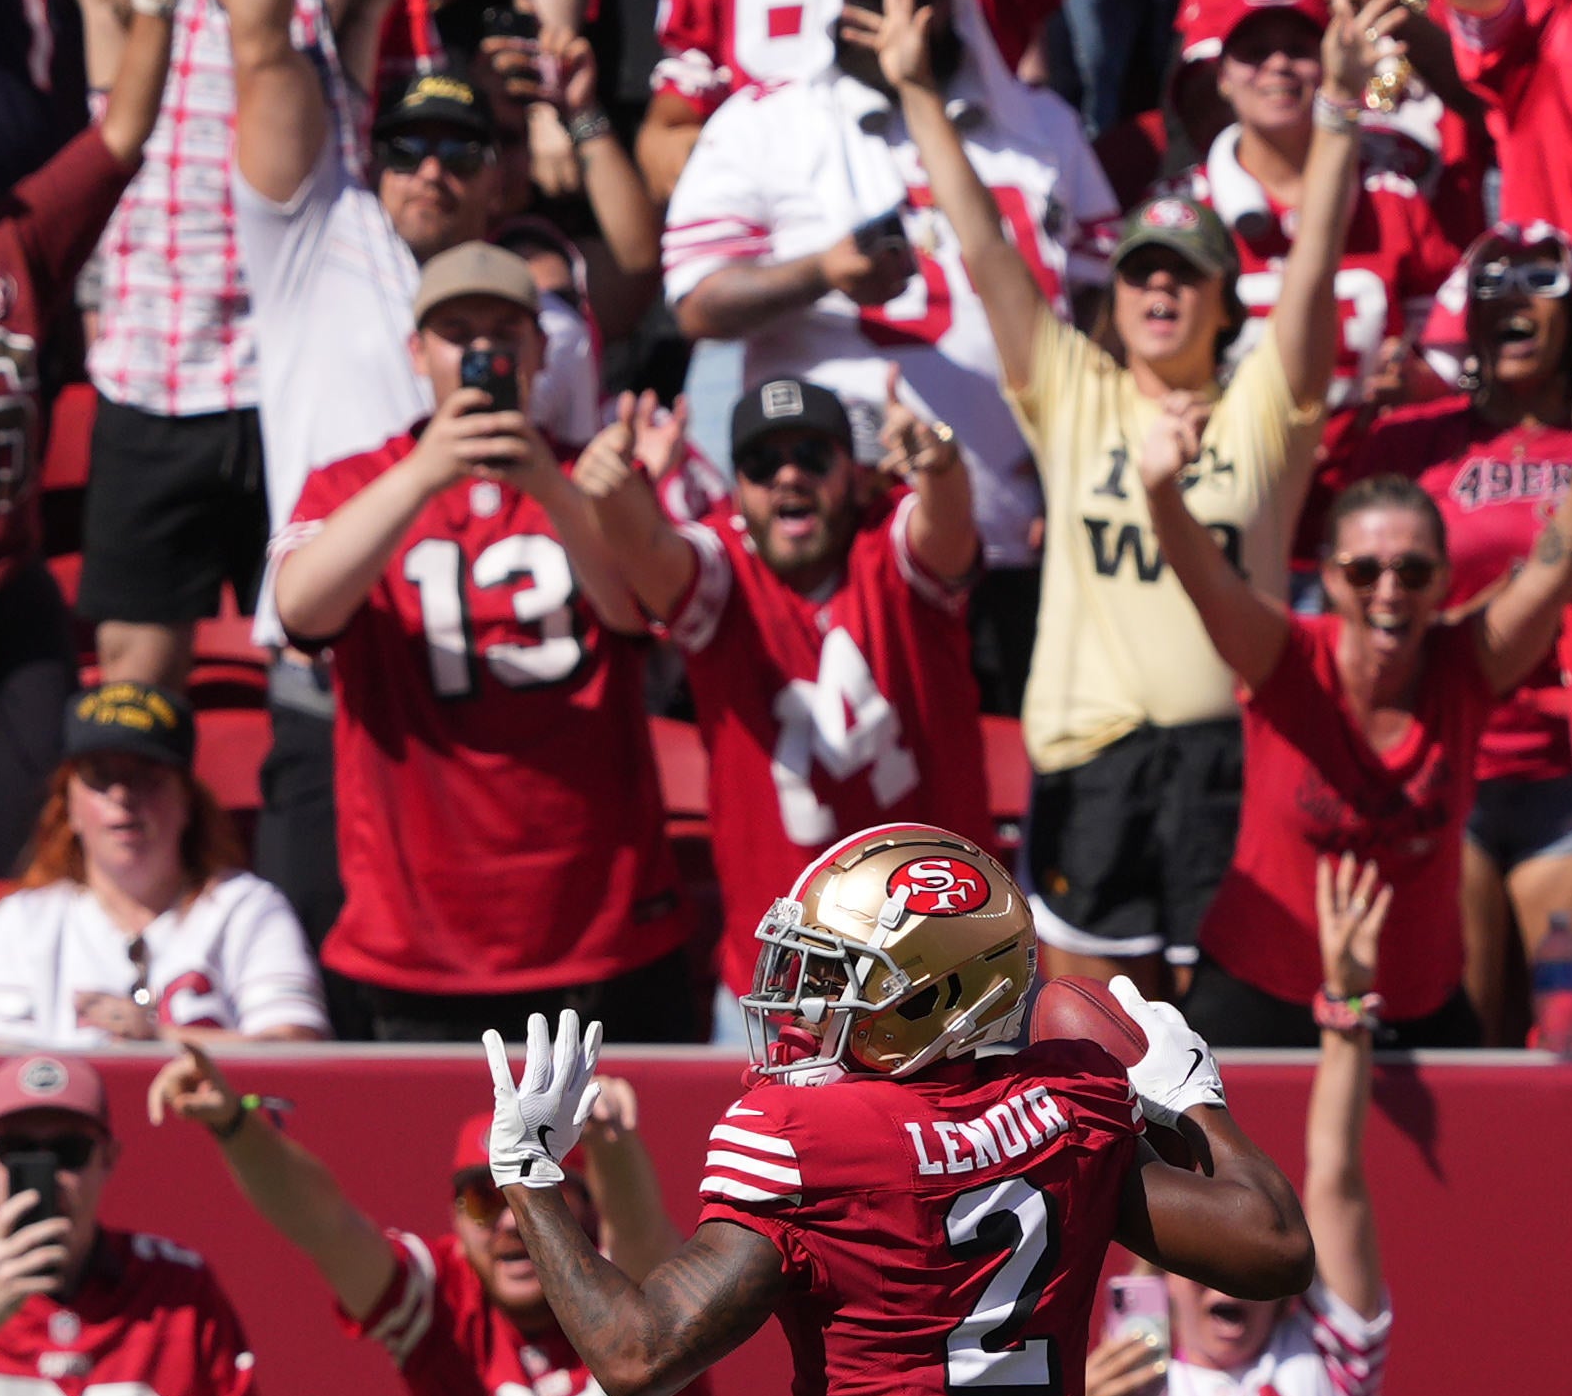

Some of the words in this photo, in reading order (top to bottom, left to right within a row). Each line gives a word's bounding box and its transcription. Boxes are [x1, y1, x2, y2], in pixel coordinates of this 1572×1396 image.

[403, 533, 588, 700] 13
[773, 625, 921, 849] 14
[908, 860, 978, 911] SF
[903, 1086, 1072, 1178] LENOIR
